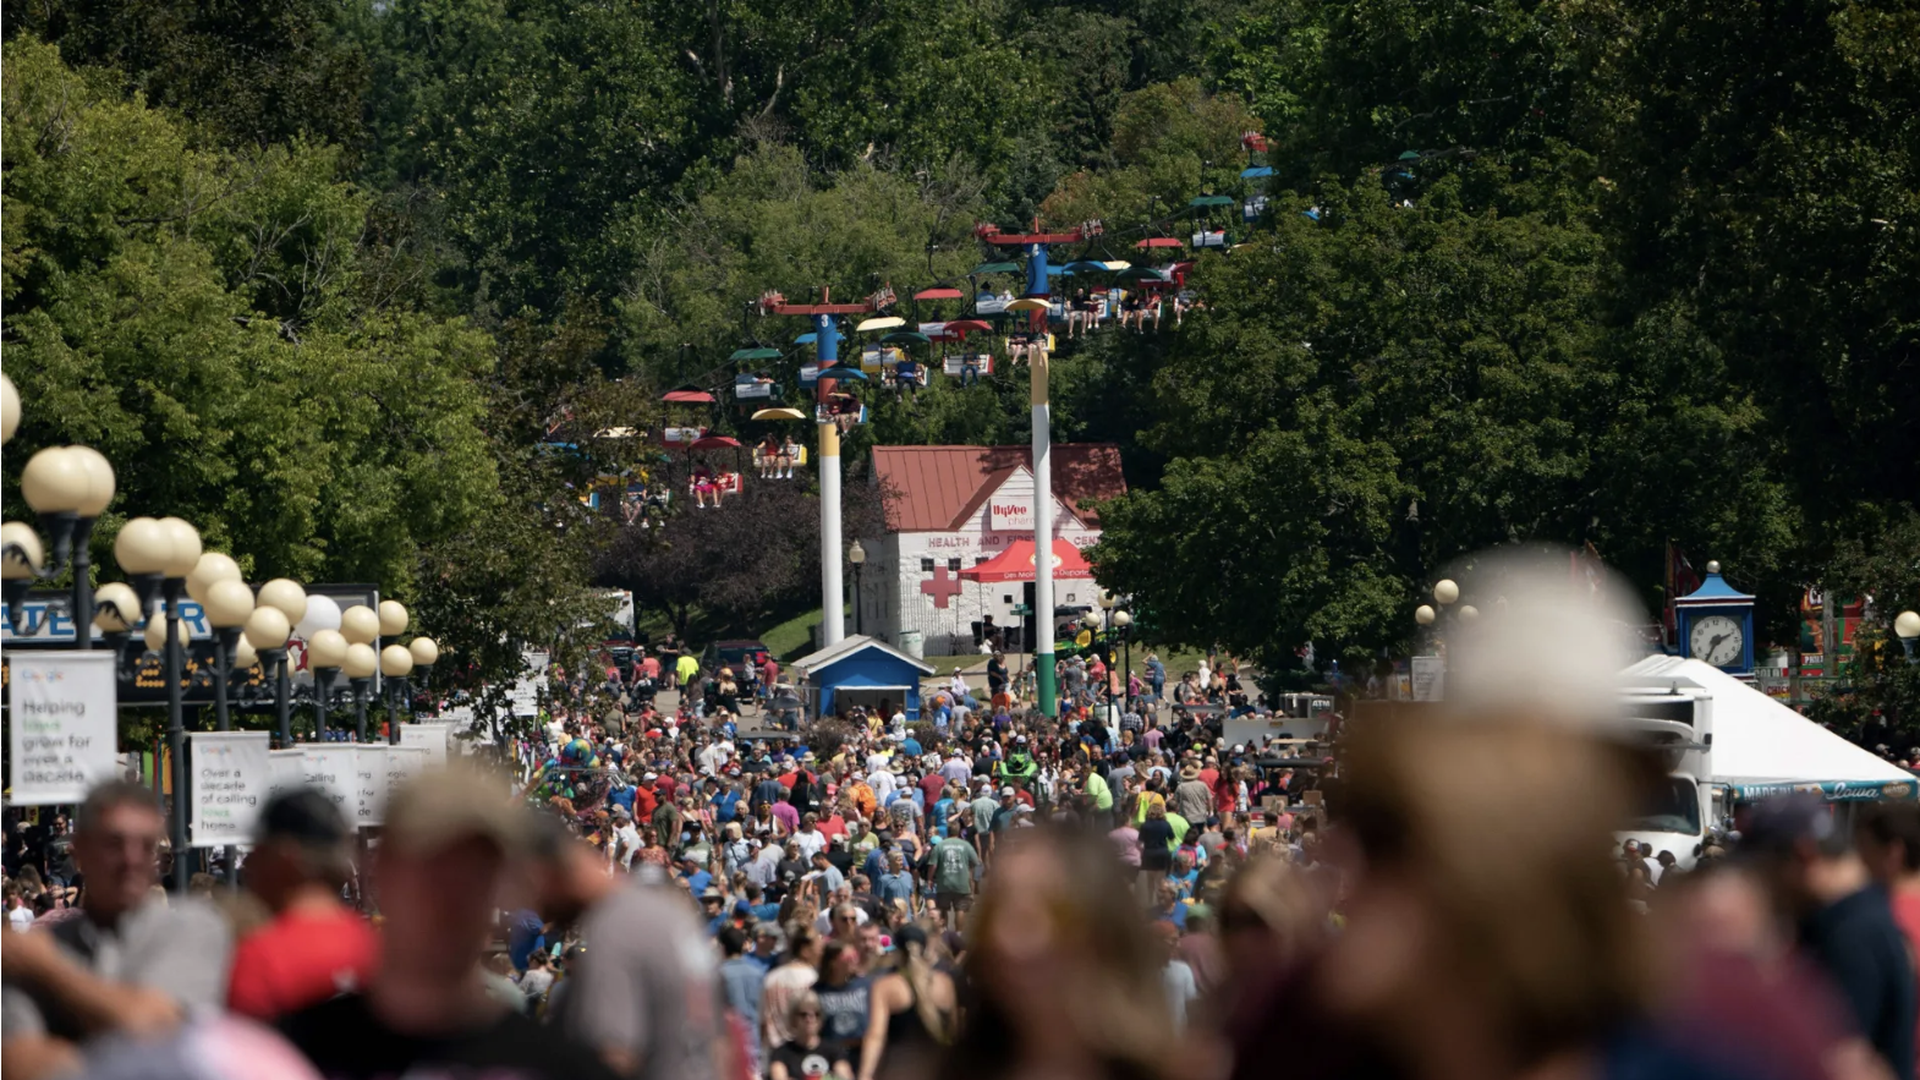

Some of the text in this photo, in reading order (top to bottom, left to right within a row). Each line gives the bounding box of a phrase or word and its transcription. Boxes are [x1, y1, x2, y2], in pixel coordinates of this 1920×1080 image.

[821, 314, 829, 328] 3
[928, 537, 970, 548] HEALTH
[977, 537, 1000, 546] AND
[1018, 571, 1036, 579] Moin
[23, 700, 86, 719] Helping
[69, 733, 92, 748] for
[64, 755, 74, 764] a
[202, 768, 242, 779] Over a
[304, 772, 336, 785] Calling
[201, 793, 258, 808] of calling
[201, 820, 236, 831] home
